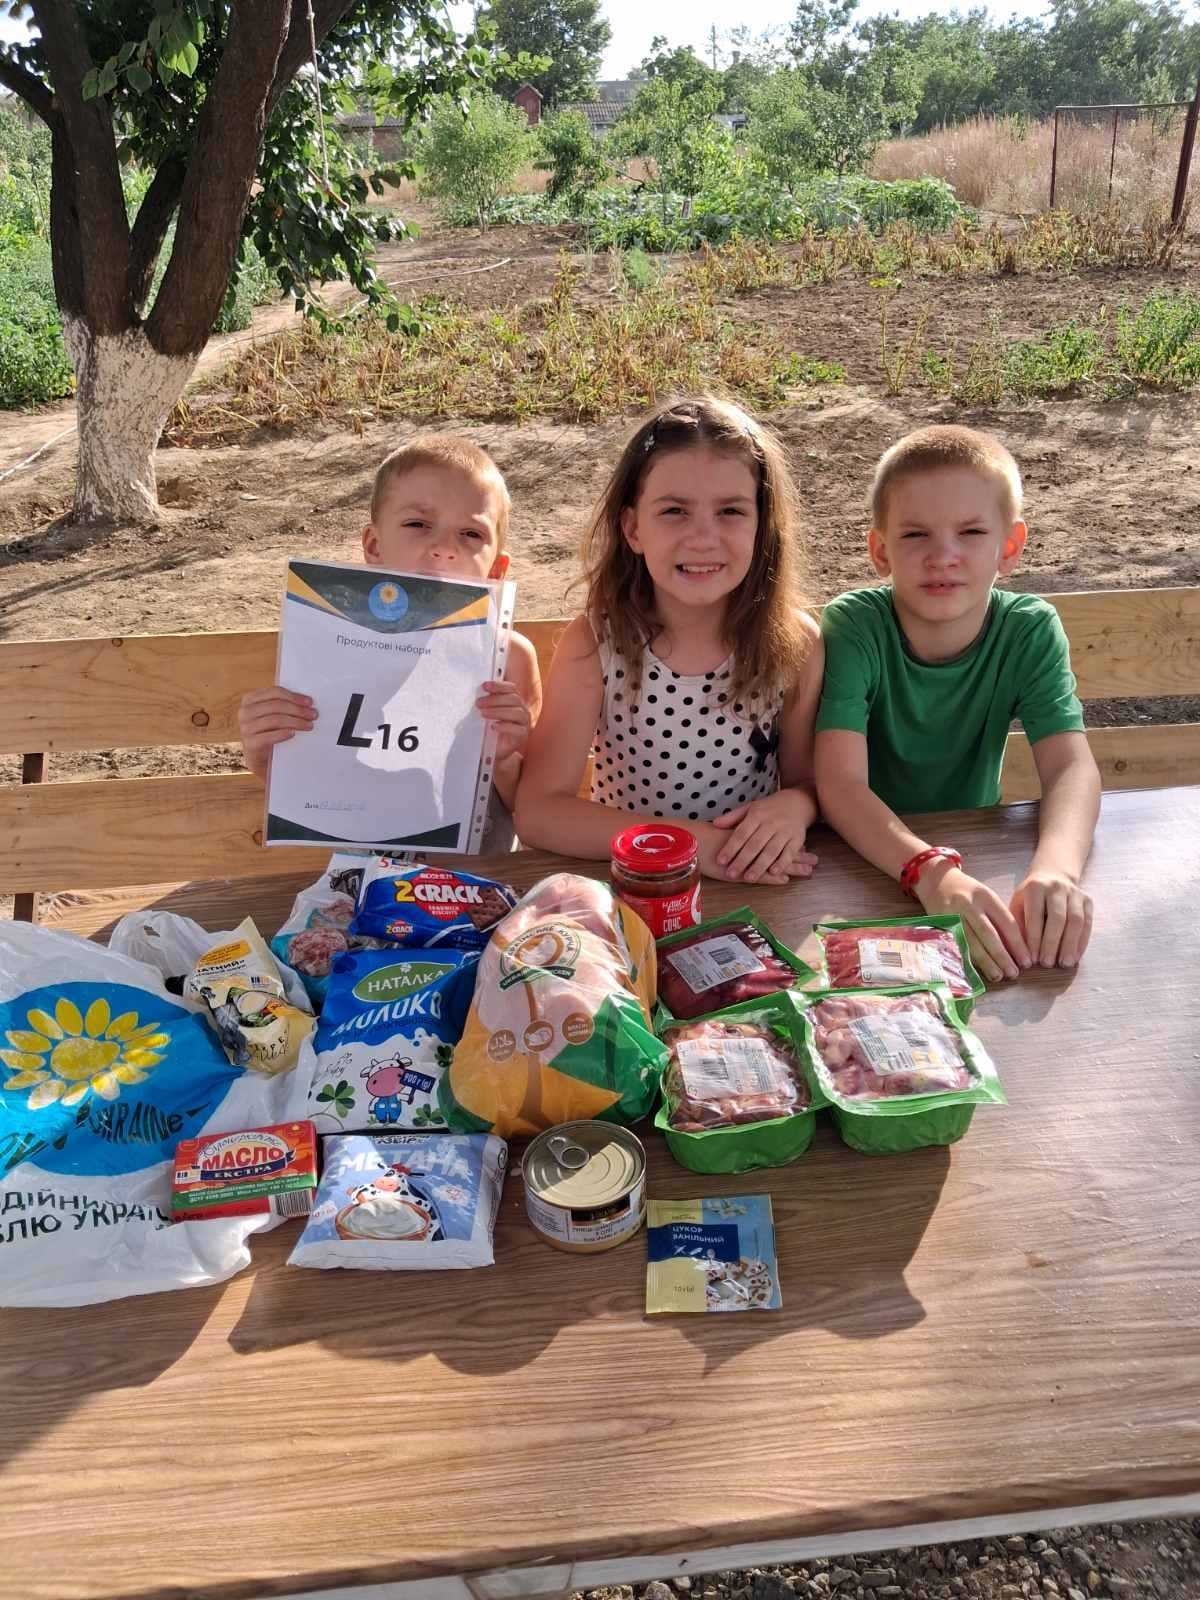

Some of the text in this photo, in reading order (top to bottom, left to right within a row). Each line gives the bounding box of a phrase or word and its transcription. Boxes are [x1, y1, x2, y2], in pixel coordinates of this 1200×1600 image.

[336, 634, 432, 657] Продуктові набори
[368, 970, 444, 993] НАТАЛКА
[202, 1147, 284, 1172] МАСЛО
[214, 1165, 272, 1179] ЕКСТРА
[672, 1225, 703, 1234] ЦУКОР
[672, 1234, 725, 1243] ВАНІЛЬНИЙ
